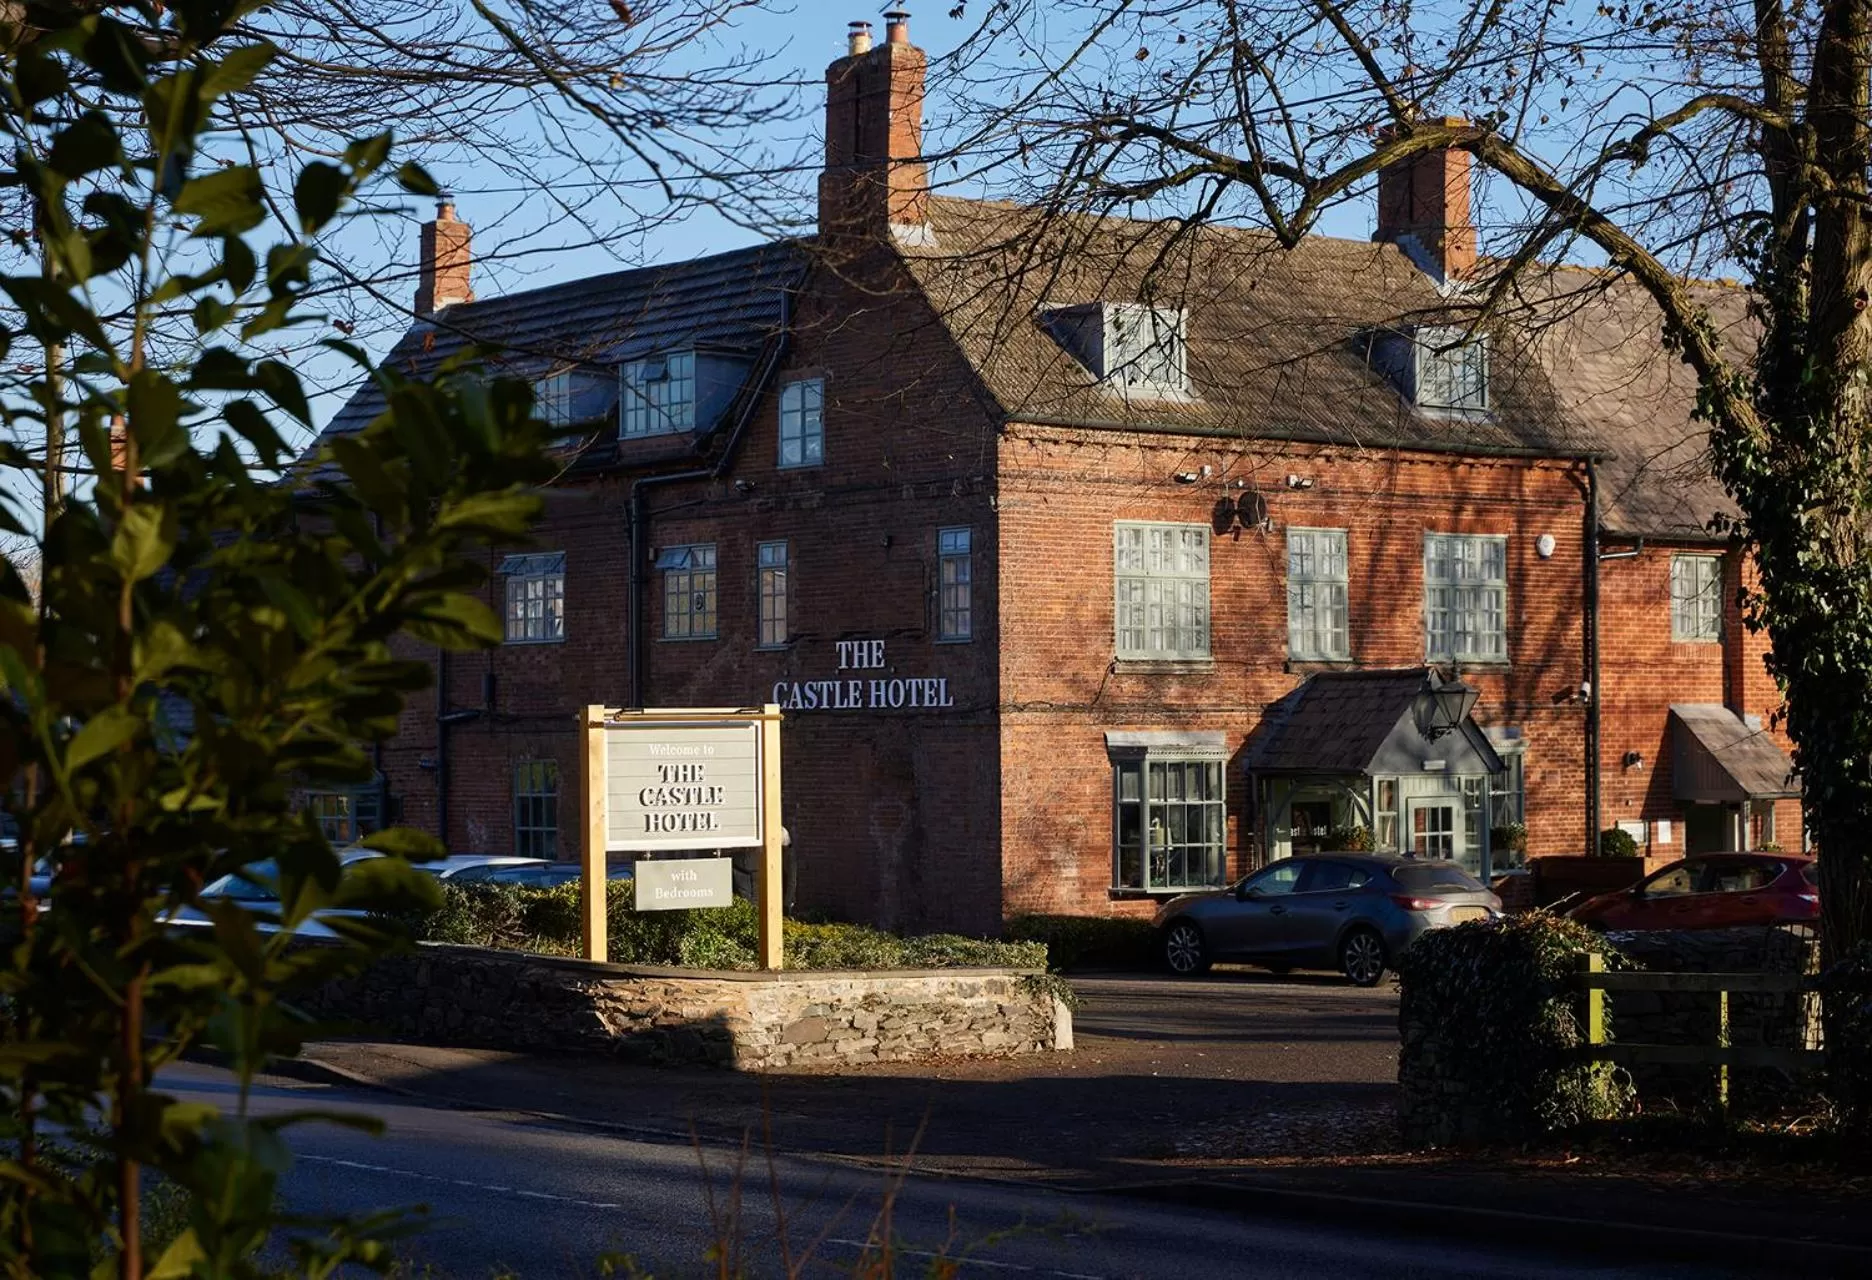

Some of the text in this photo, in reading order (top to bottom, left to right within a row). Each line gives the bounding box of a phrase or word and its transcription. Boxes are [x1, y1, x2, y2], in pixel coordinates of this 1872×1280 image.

[835, 640, 885, 669] THE
[773, 678, 954, 710] CASTLE HOTEL
[648, 743, 715, 756] Welcome to
[657, 763, 706, 784] THE
[638, 785, 726, 807] CASTLE
[643, 811, 722, 833] HOTEL
[670, 869, 697, 882] with
[655, 887, 714, 901] Bedrooms
